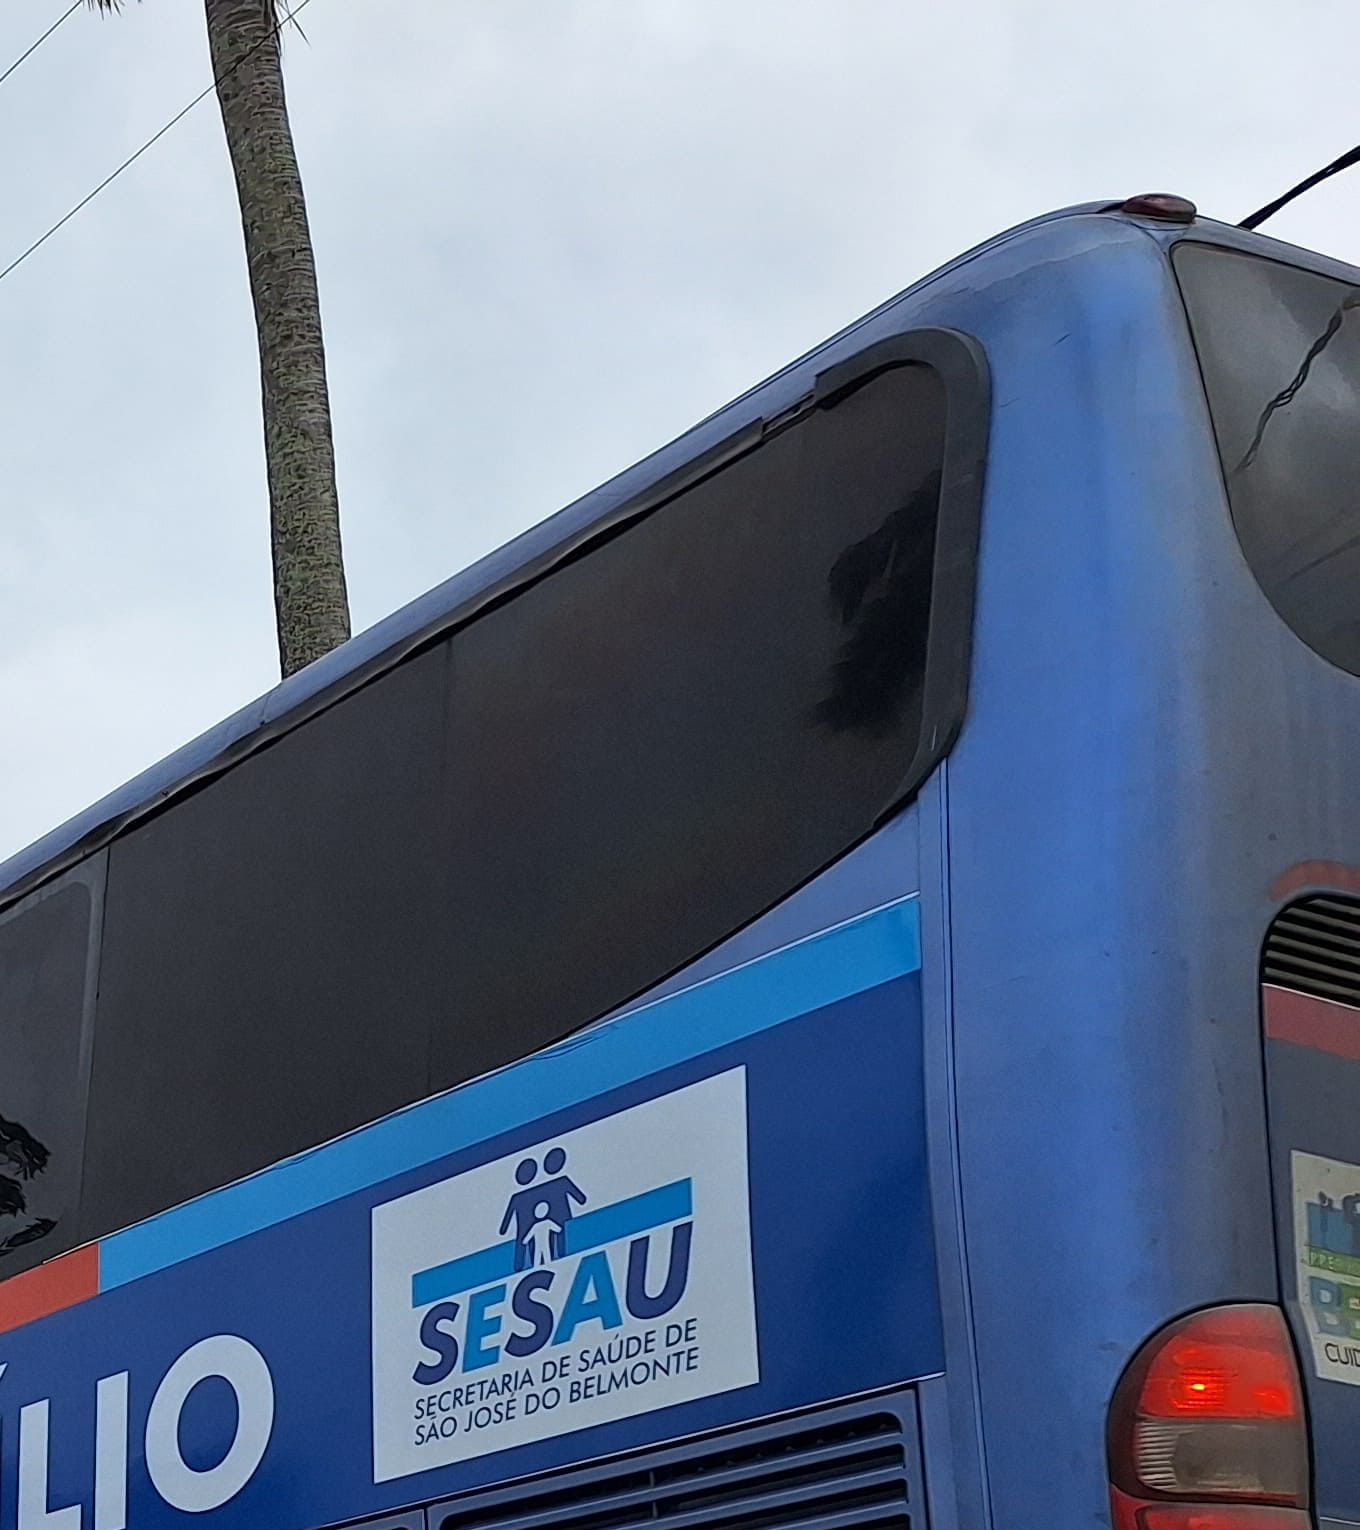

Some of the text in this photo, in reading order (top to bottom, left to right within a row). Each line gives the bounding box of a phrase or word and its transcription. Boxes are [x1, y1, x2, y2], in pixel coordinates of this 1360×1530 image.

[412, 1220, 694, 1385] SESAU
[414, 1318, 698, 1420] SECRETARIA DE SAÚDE DE
[414, 1346, 700, 1446] SÃO JOSÉ DO BELMONTE
